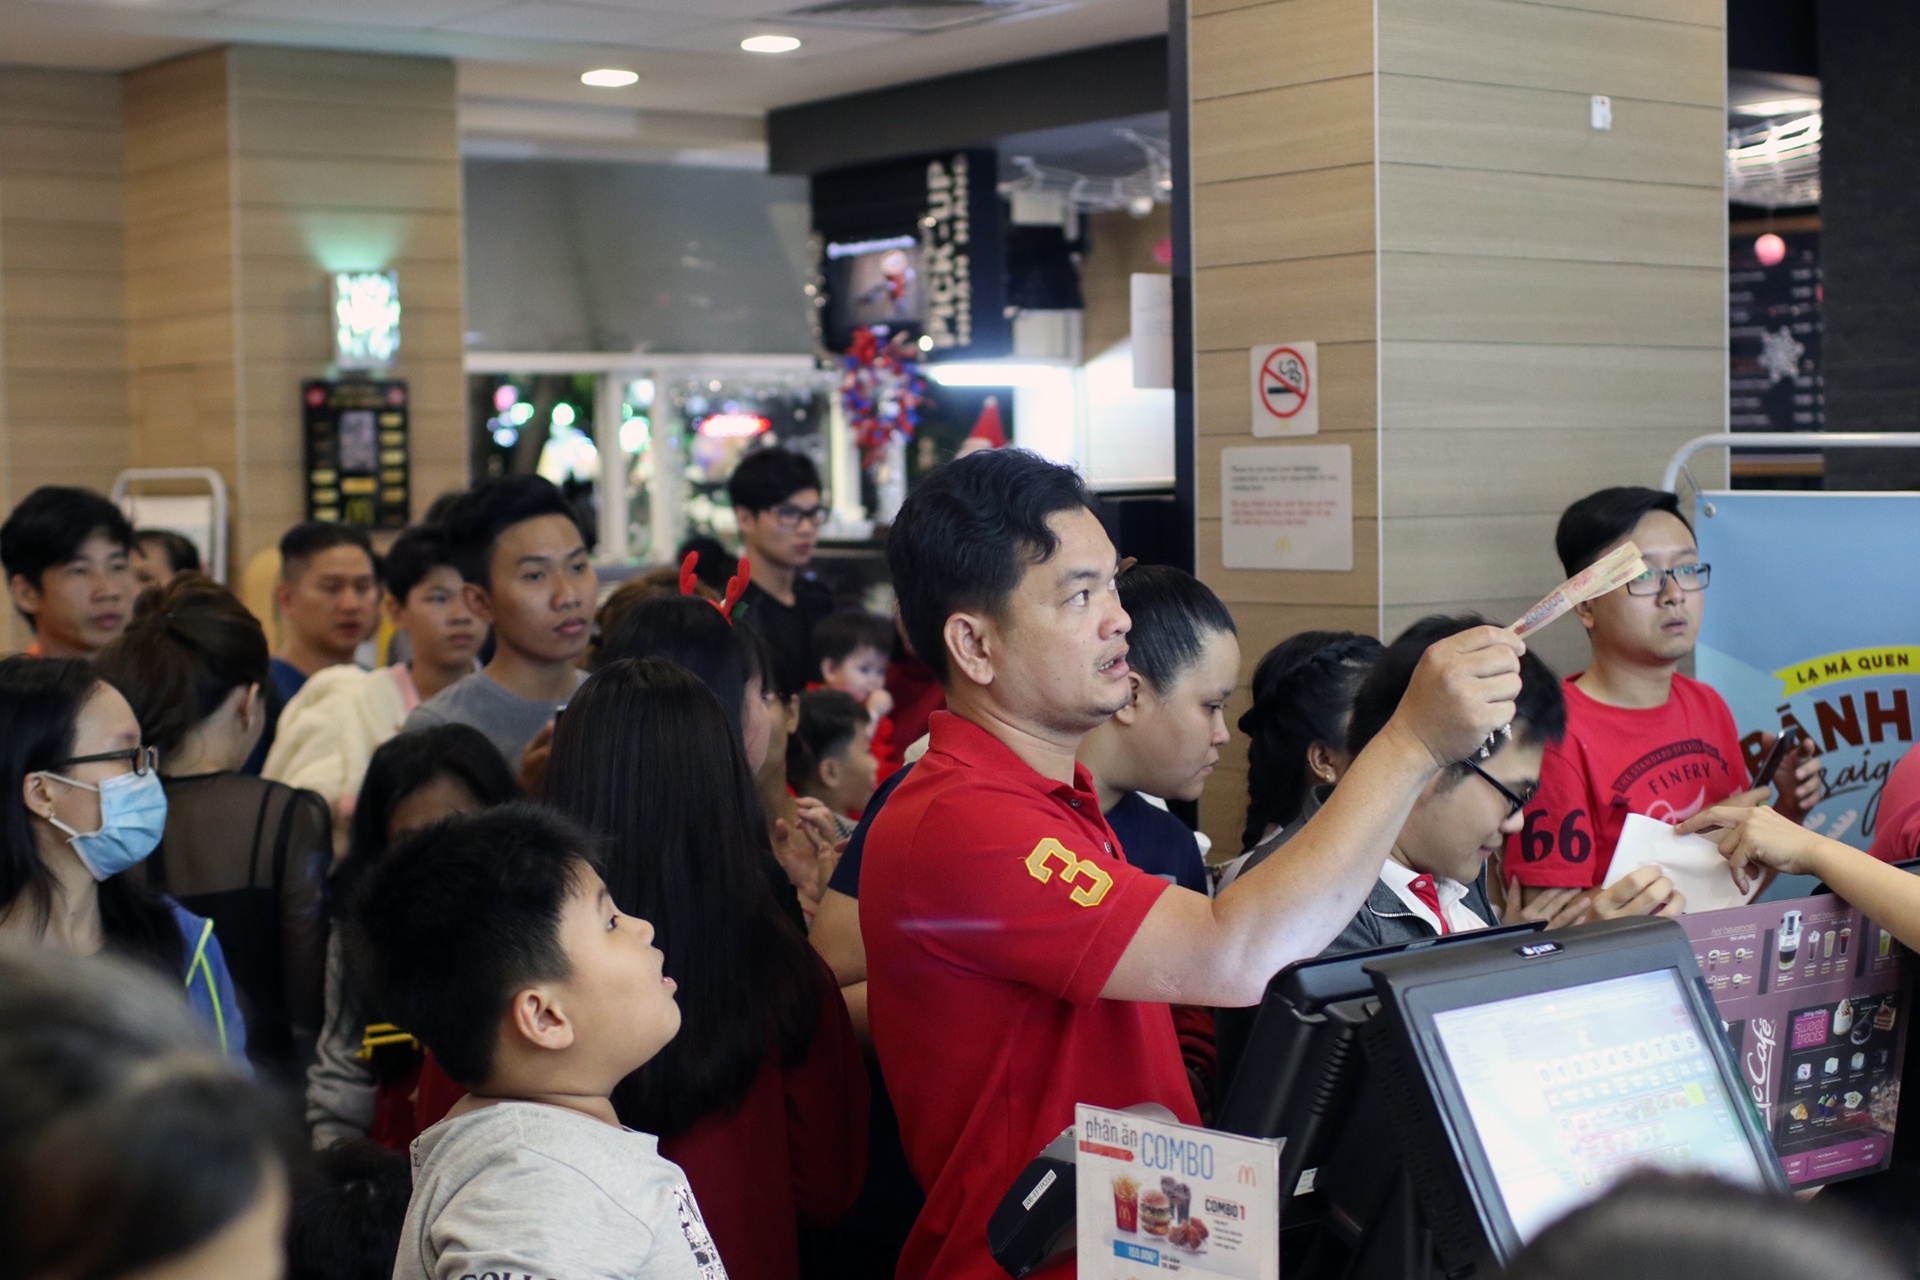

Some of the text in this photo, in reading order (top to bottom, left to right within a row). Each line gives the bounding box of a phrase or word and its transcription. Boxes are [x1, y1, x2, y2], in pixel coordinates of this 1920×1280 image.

[1858, 652, 1909, 671] QUEN
[1648, 762, 1711, 795] FINERY
[1818, 749, 1901, 837] saig
[1520, 808, 1592, 864] 66
[1025, 838, 1114, 907] 3
[1795, 1018, 1825, 1035] sweet
[1797, 1030, 1824, 1045] treats
[1747, 1018, 1776, 1117] cCafé
[1086, 1117, 1214, 1180] phần ăn COMBO
[1205, 1198, 1246, 1221] COMBO 1
